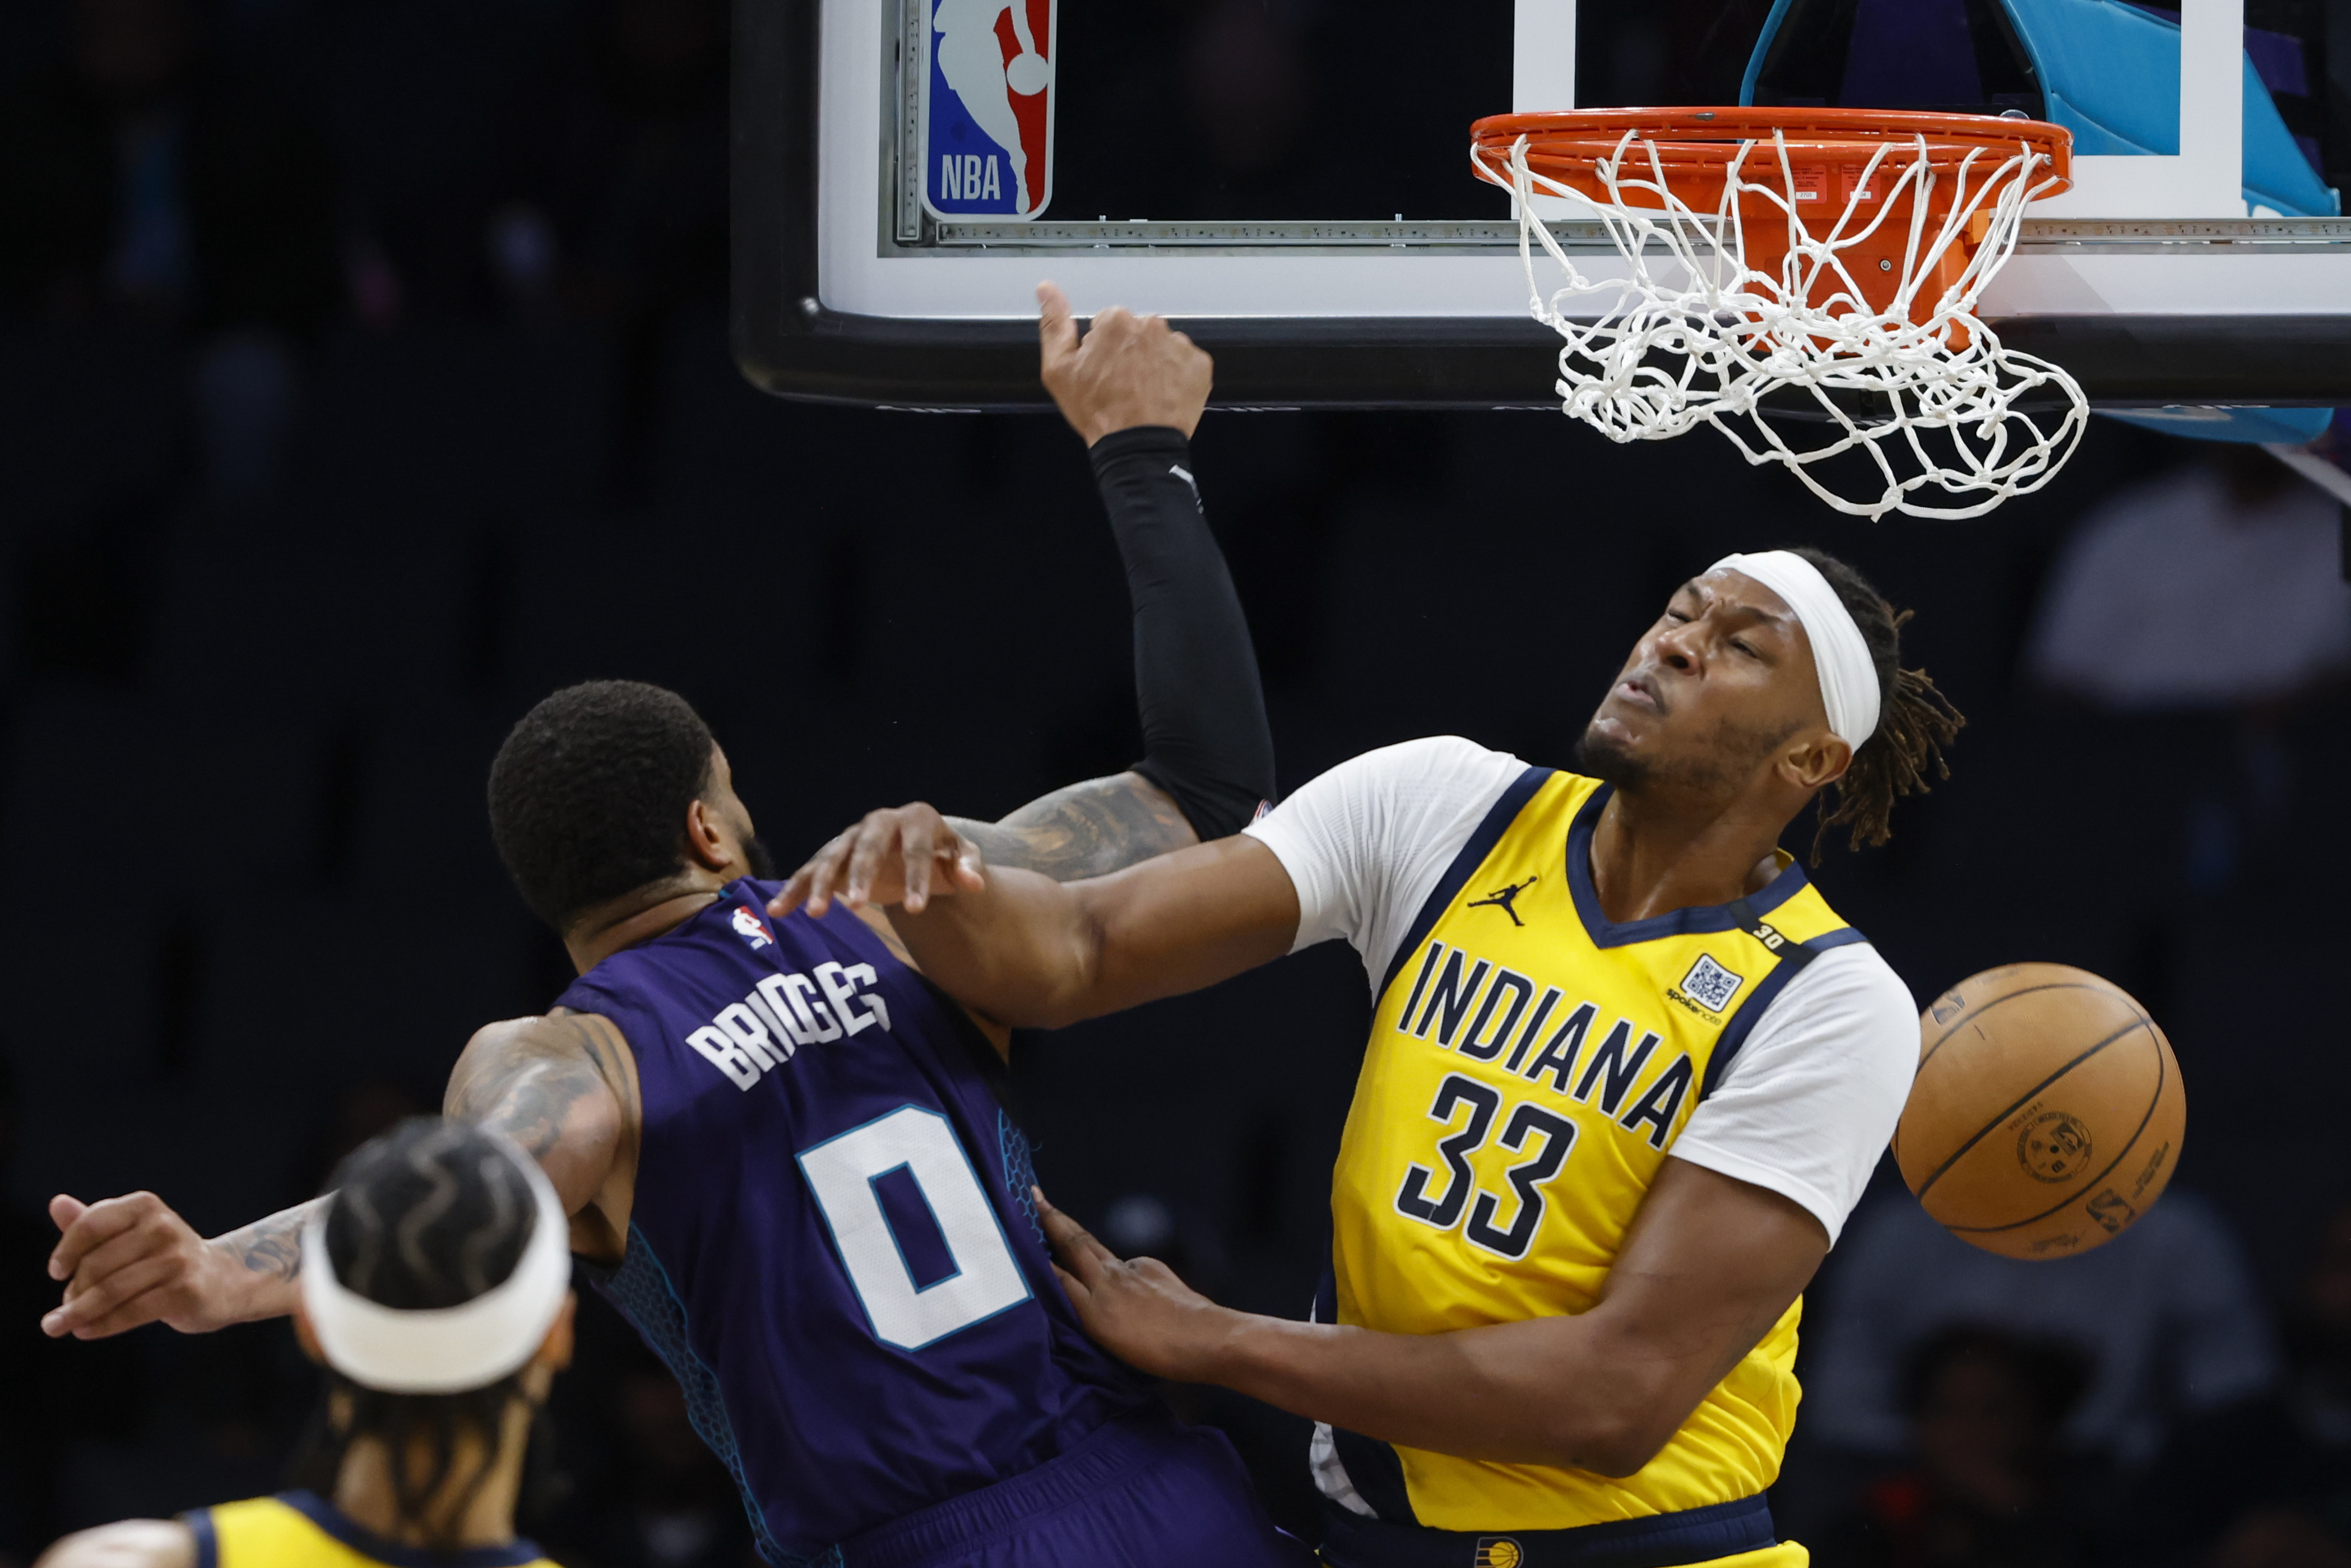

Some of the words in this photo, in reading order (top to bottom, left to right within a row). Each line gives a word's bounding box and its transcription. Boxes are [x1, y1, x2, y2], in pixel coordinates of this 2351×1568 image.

[942, 154, 1001, 200] NBA
[1752, 925, 1784, 950] 30
[685, 961, 891, 1092] BRIDGES
[1396, 939, 1694, 1152] INDIANA
[1667, 989, 1722, 1026] spokenote
[794, 1103, 1035, 1353] 0
[1394, 1071, 1579, 1262] 33
